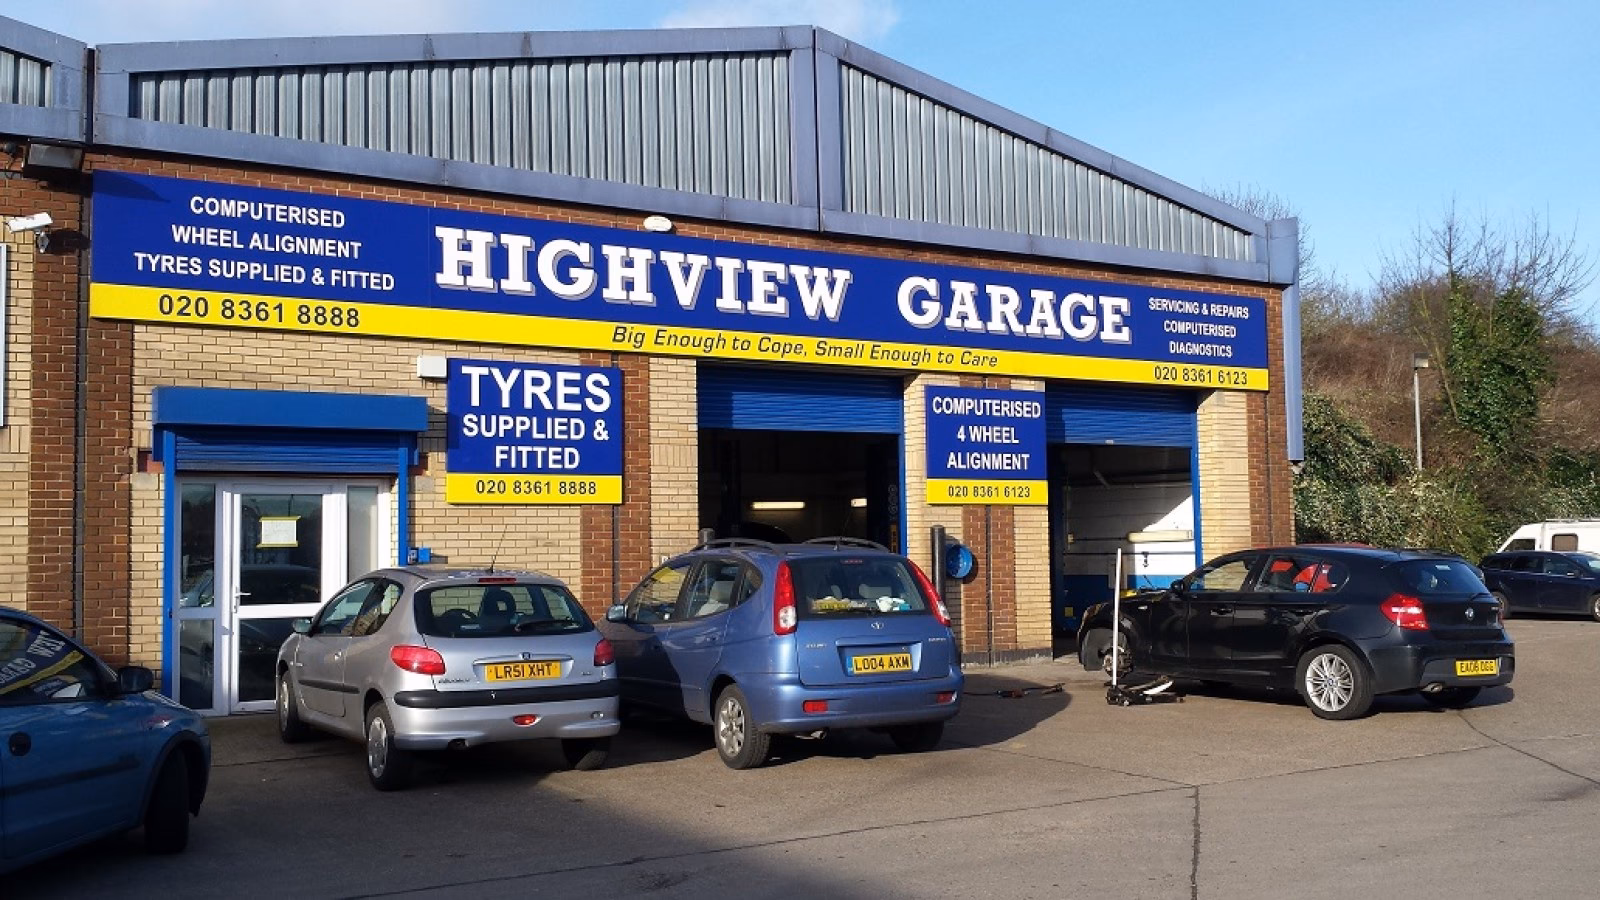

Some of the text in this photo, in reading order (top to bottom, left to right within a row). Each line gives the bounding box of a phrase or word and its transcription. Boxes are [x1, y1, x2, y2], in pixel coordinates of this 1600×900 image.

[190, 197, 345, 228] COMPUTERISED
[171, 224, 362, 259] WHEEL ALIGNMENT
[134, 252, 395, 291] TYRES SUPPLIED & FITTED
[435, 226, 1133, 344] HIGHVIEW GARAGE
[159, 294, 360, 328] 020 8361 8888
[1148, 297, 1249, 319] SERVICING & REPAIRS
[1163, 320, 1237, 338] COMPUTERISED
[612, 325, 998, 368] Big Enough to Cope, Small Enough to Care
[1168, 341, 1233, 358] DIAGNOSTICS
[1154, 365, 1247, 385] 020 8361 6123
[462, 365, 611, 413] TYRES
[932, 397, 1041, 418] COMPUTERISED
[462, 414, 609, 441] SUPPLIED &
[957, 425, 1020, 443] 4 WHEEL
[495, 445, 580, 469] FITTED
[947, 452, 1030, 470] ALIGNMENT
[476, 480, 596, 495] 020 8361 8888
[948, 486, 1030, 498] 020 8361 6123
[494, 663, 552, 679] LR51 XHT
[888, 656, 910, 669] AXM
